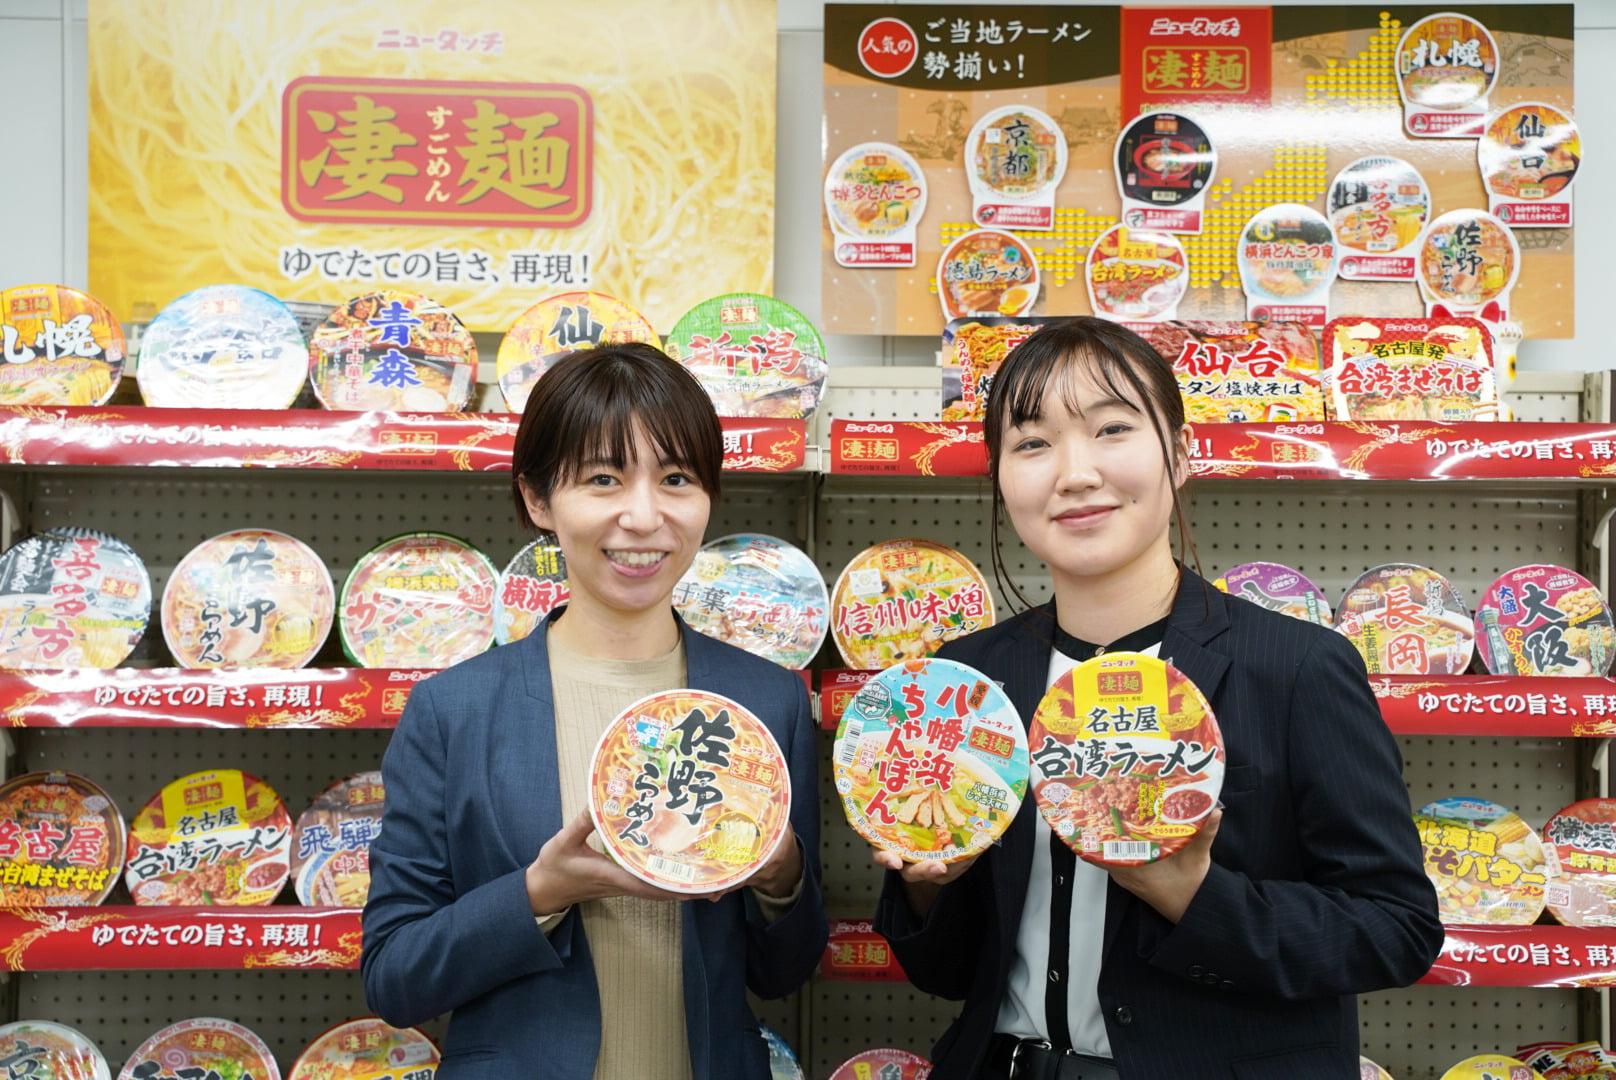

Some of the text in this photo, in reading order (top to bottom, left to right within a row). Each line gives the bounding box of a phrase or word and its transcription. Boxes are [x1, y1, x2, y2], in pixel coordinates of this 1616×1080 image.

[377, 30, 503, 53] ニュータッチ
[923, 19, 1092, 45] ご当地ラーメン
[1150, 17, 1240, 37] ニュータッチ
[863, 35, 912, 55] 人気の
[1411, 38, 1484, 68] 札幌
[923, 53, 1025, 81] 勢揃い！
[1147, 49, 1244, 88] 凄麺
[300, 95, 571, 209] 凄麺
[425, 106, 453, 203] すごめん
[1003, 119, 1030, 174] 京都
[832, 184, 921, 201] 博多とんこつ
[1124, 248, 1154, 258] 名古屋
[1454, 220, 1483, 276] 佐野
[282, 247, 591, 284] ゆでたての旨さ、再現！
[947, 261, 1032, 281] 徳島ラーメン
[1092, 262, 1184, 282] 台湾ラーメン
[369, 301, 422, 388] 青森
[684, 330, 804, 376] 新潟
[1174, 340, 1286, 378] 仙台
[1373, 341, 1446, 360] 名古屋発
[1177, 381, 1303, 397] タン塩焼そば
[1337, 362, 1489, 397] 台湾まぜそば
[845, 424, 894, 433] ニュータッチ
[841, 440, 897, 459] 凄麺
[1426, 438, 1616, 461] ゆでたての旨さ、再
[32, 536, 101, 660] 喜多方
[226, 538, 276, 634] 佐野
[676, 582, 731, 612] 千葉
[1498, 585, 1518, 615] 大盛
[837, 583, 985, 637] 信州味噌
[932, 621, 982, 637] ラーメン
[1375, 584, 1430, 675] 長岡
[1517, 582, 1580, 673] 大阪
[1101, 660, 1136, 668] ニュータッチ
[94, 685, 323, 708] ゆでたての旨さ、再現！
[1101, 674, 1140, 691] 凄麺
[980, 717, 1014, 732] ニュータッチ
[1086, 705, 1160, 734] 名古屋
[915, 683, 970, 792] 八幡浜
[971, 730, 1012, 757] 凄麺
[665, 708, 736, 826] 佐野
[865, 683, 926, 826] ちゃんぽん
[1031, 736, 1217, 780] 台湾ラーメン
[730, 758, 774, 784] 凄麺
[619, 763, 660, 847] らーめん
[177, 806, 240, 836] 名古屋
[129, 826, 289, 881] 台湾ラーメン
[299, 818, 382, 859] 飛騨
[1416, 820, 1498, 857] 北海道
[0, 864, 109, 891] 台湾まぜそば
[1422, 845, 1547, 888] そバター
[1501, 884, 1545, 897] ラーメン
[92, 923, 321, 947] ゆでたての旨さ、再現！
[834, 943, 888, 964] 凄麺
[1440, 942, 1616, 967] でたての旨さ、再
